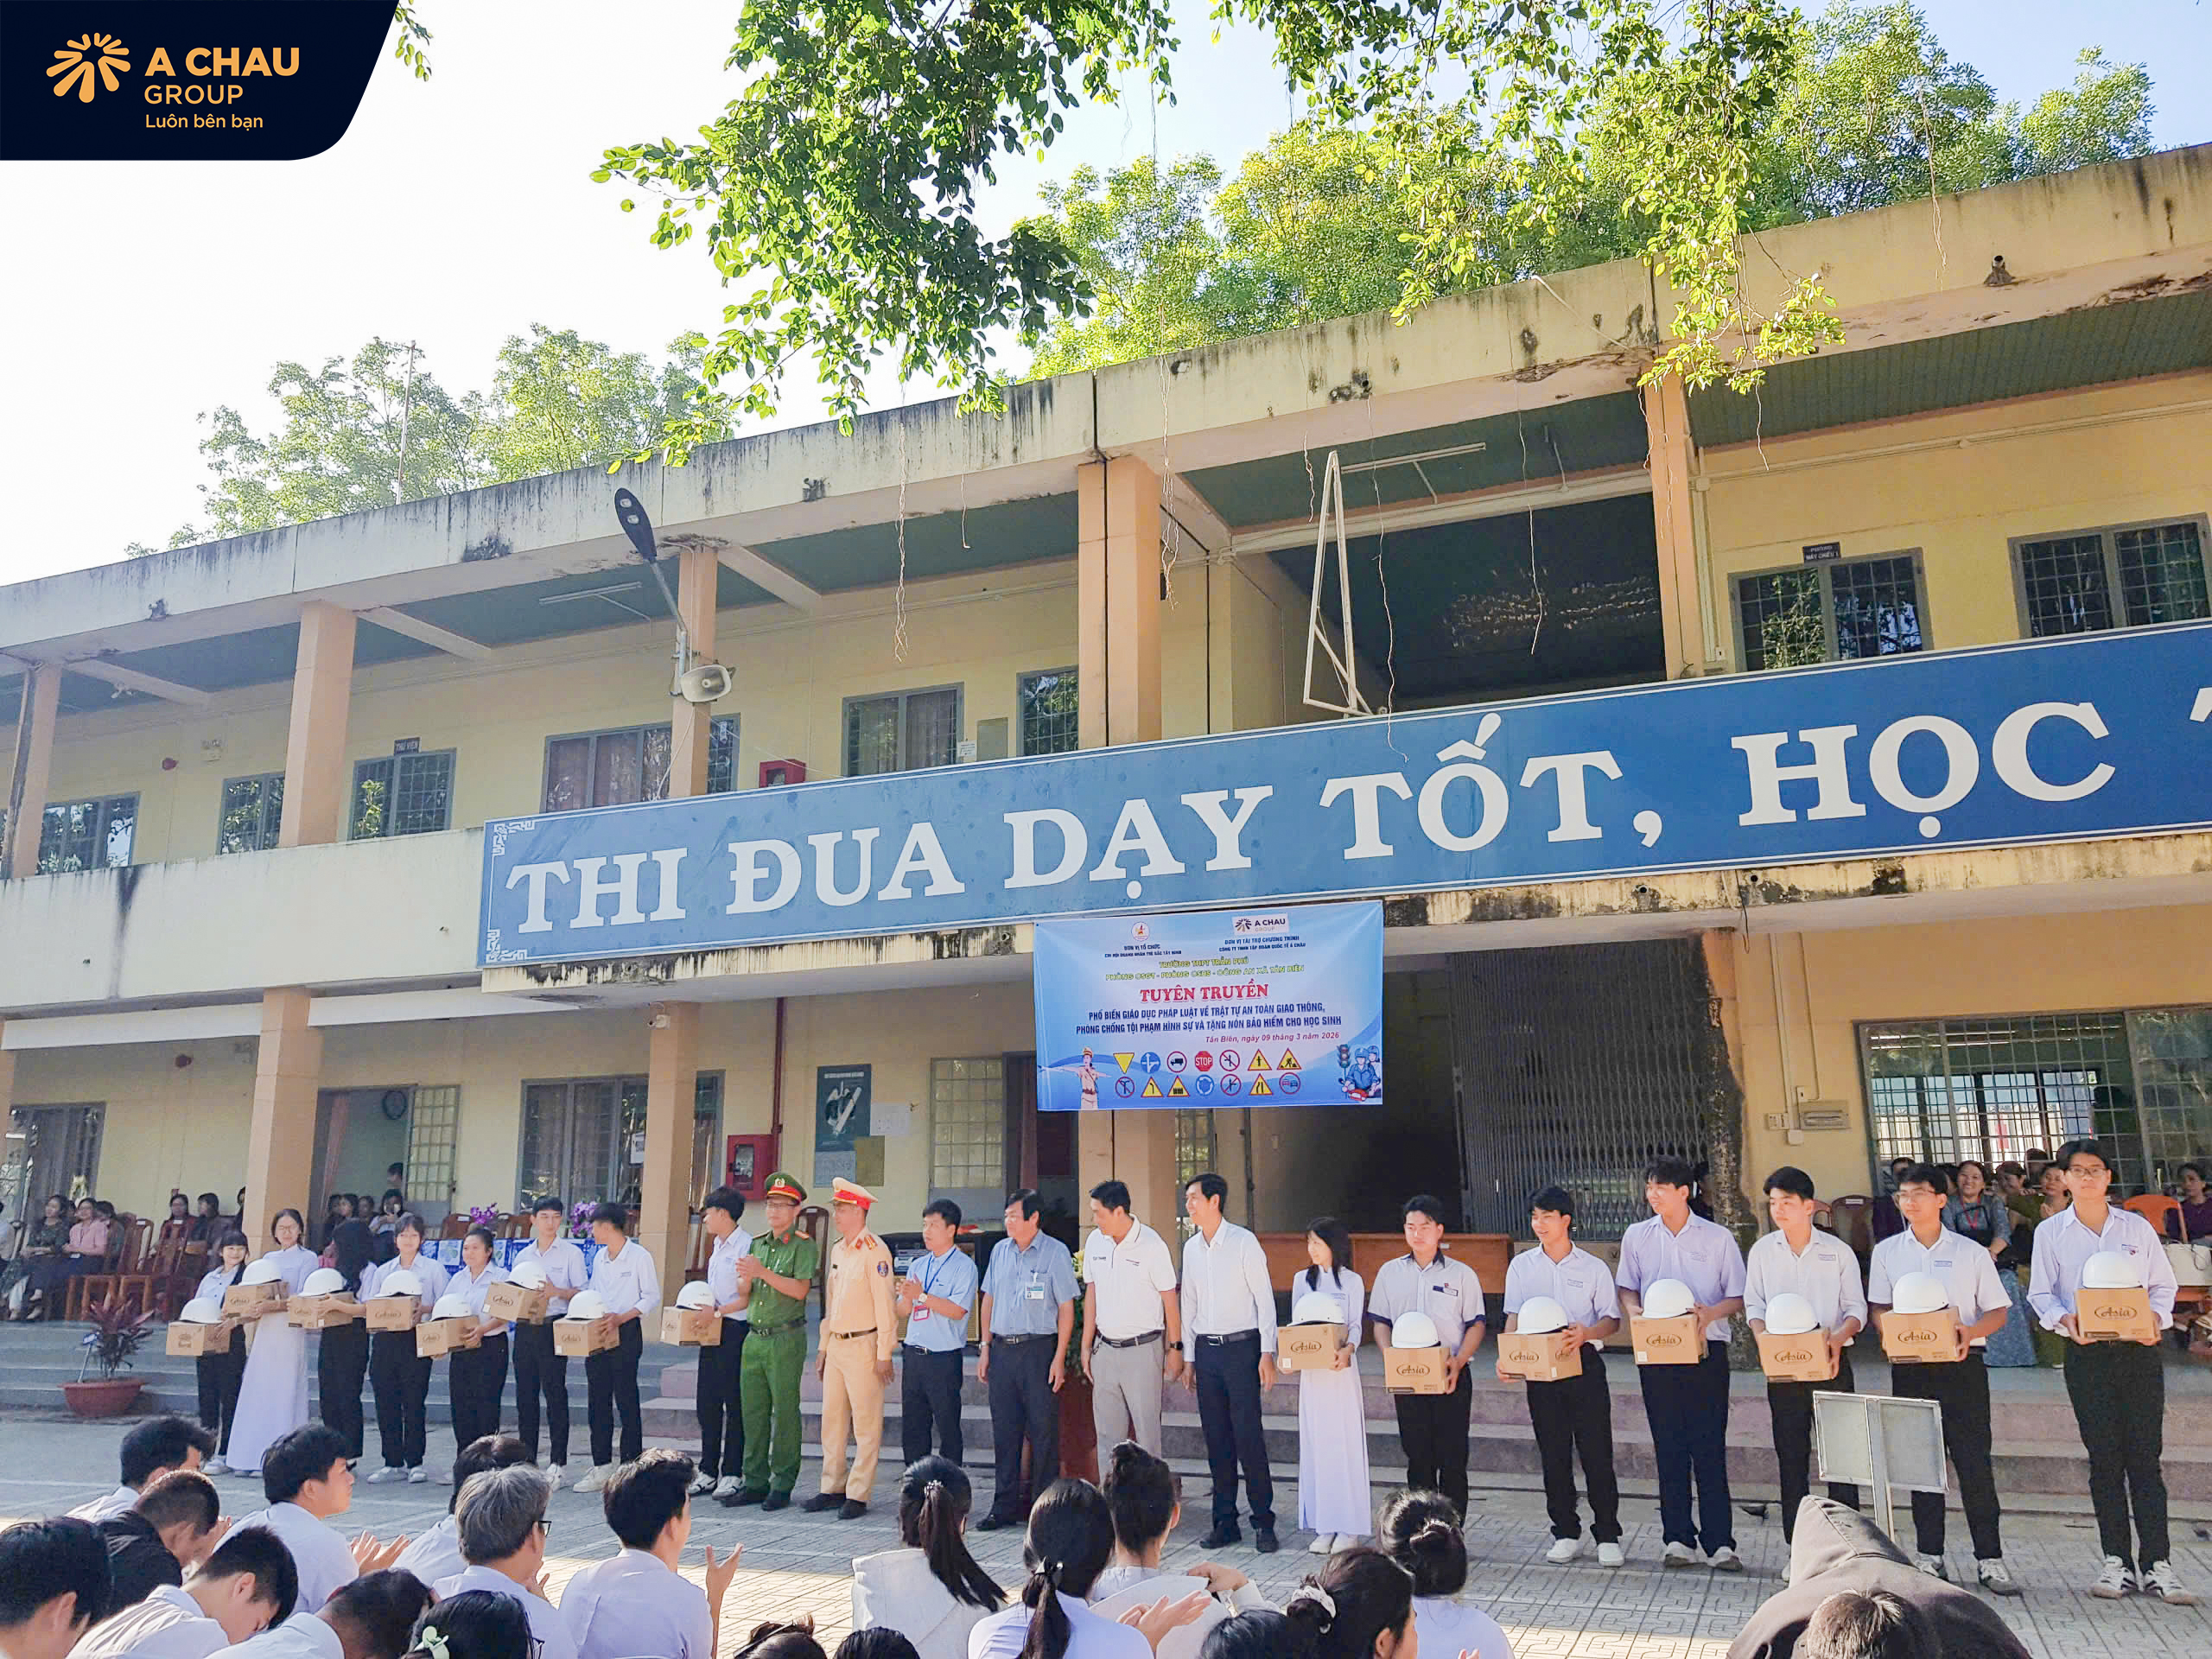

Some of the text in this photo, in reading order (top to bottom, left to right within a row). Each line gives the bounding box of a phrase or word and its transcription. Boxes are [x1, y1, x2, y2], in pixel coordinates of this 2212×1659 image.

[506, 702, 2116, 933] THI ĐUA DẠY TỐT, HỌC
[1140, 978, 1268, 1001] TUYÊN TRUYỀN
[1122, 1008, 1139, 1019] GIÁO
[1141, 1009, 1156, 1020] DỤC
[1158, 1007, 1178, 1019] PHÁP
[1180, 1006, 1198, 1019] LUẬT
[1211, 1006, 1229, 1018] TRẬT
[1230, 1005, 1241, 1018] TỰ
[1243, 1005, 1253, 1014] AN
[1255, 1003, 1274, 1014] TOÀN
[1276, 1003, 1294, 1014] GIAO
[1296, 1001, 1325, 1013] THÔNG,
[1101, 1021, 1126, 1033] CHỐNG
[1127, 1021, 1138, 1034] TỘI
[1140, 1023, 1161, 1034] PHẠM
[1163, 1020, 1180, 1031] HÌNH
[1183, 1020, 1193, 1033] SỰ
[1194, 1020, 1205, 1031] VÀ
[1228, 1018, 1244, 1029] NÓN
[1286, 1017, 1301, 1027] CHO
[1303, 1016, 1319, 1028] HỌC
[1322, 1015, 1341, 1026] SINH
[1241, 1034, 1260, 1044] ngày
[1272, 1033, 1294, 1043] tháng
[1195, 1057, 1212, 1066] STOP
[2101, 1306, 2131, 1319] Asia
[1652, 1334, 1677, 1345] Asia
[1904, 1331, 1932, 1343] Asia
[1294, 1340, 1319, 1352] Asia
[1514, 1351, 1536, 1363] Asia
[1780, 1351, 1806, 1362] Asia
[1401, 1364, 1427, 1376] Asia
